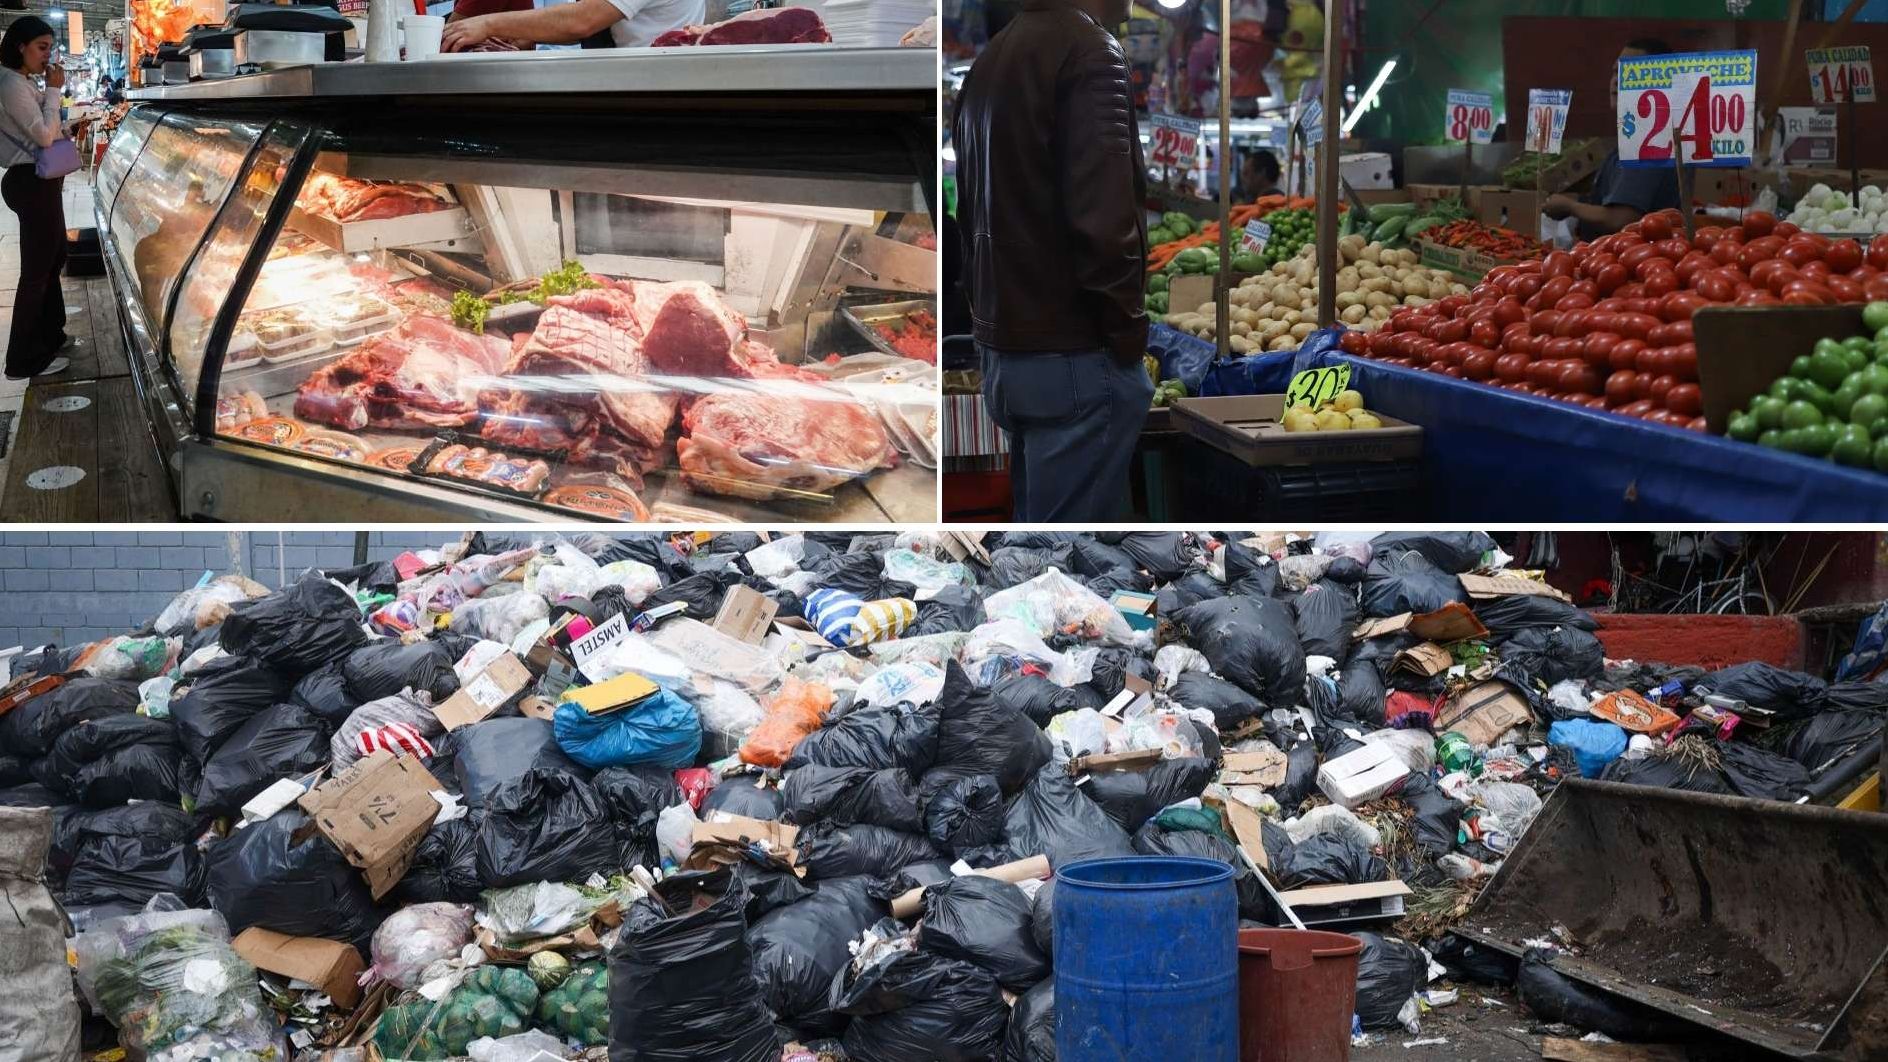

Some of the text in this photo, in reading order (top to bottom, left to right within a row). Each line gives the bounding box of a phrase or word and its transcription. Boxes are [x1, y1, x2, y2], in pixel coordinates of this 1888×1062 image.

[1451, 104, 1468, 140] 8
[1622, 75, 1745, 161] $ 24 00
[1712, 139, 1745, 154] KILO
[1285, 390, 1297, 409] $
[577, 619, 622, 656] AMSTEL
